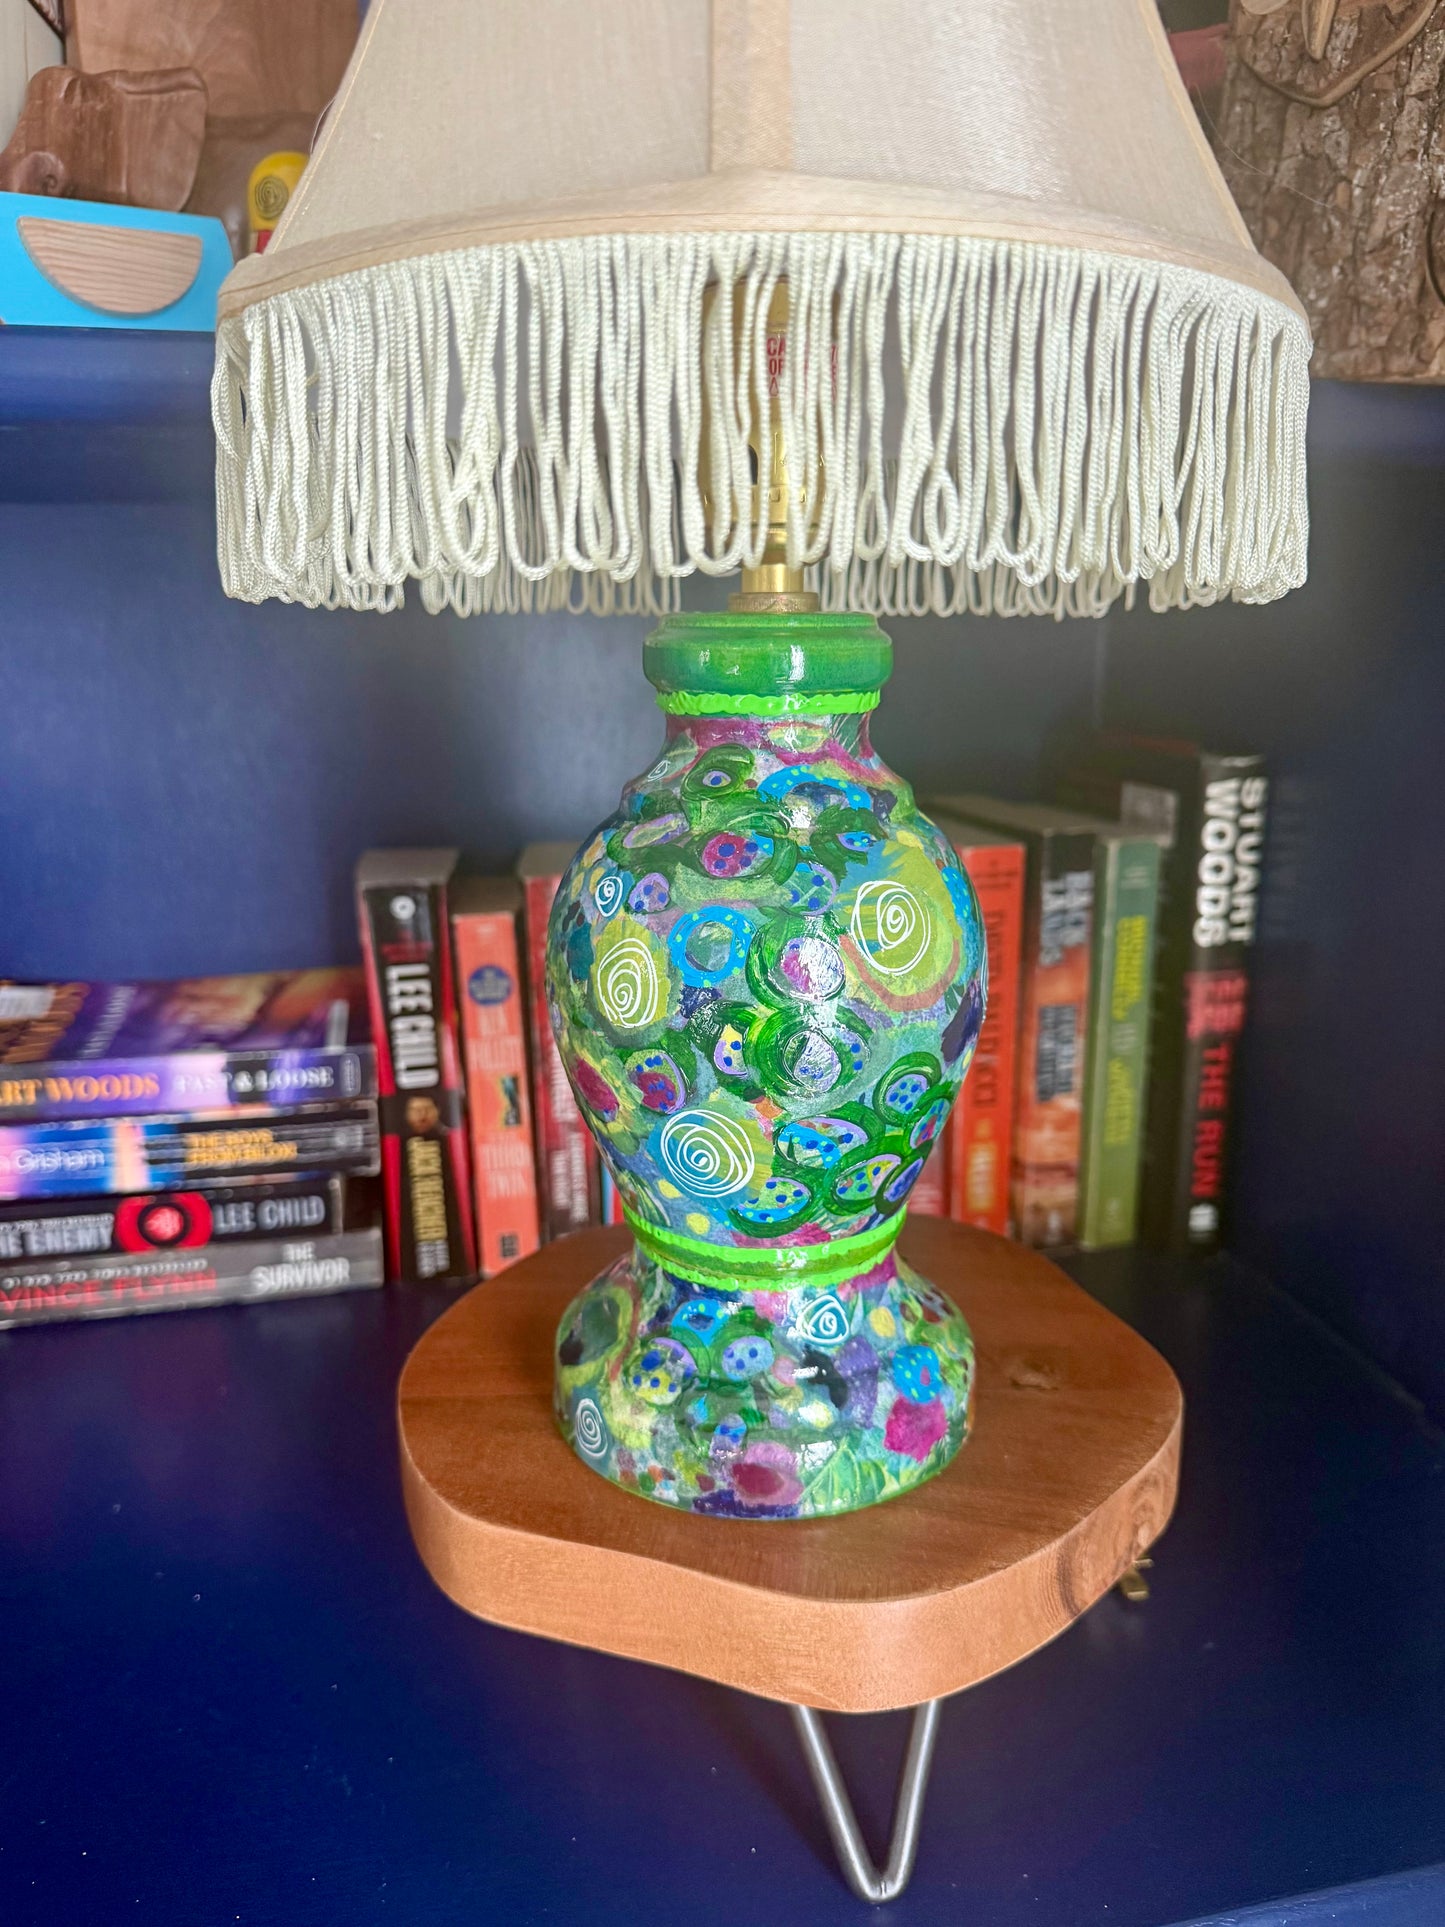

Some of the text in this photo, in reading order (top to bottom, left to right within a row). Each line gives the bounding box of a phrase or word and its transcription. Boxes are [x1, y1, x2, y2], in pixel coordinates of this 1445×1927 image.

[1193, 778, 1240, 947] WOODS
[1228, 777, 1267, 943] STUART
[386, 963, 433, 1015] LEE
[390, 1014, 440, 1090] CHILD
[44, 1073, 160, 1103] WOODS
[232, 1070, 254, 1093] &
[255, 1066, 334, 1092] LOOSE
[1197, 1044, 1229, 1111] THE
[14, 1149, 105, 1174] Grisham
[1190, 1120, 1224, 1197] RUN
[214, 1196, 326, 1234] LEE CHILD
[25, 1225, 113, 1256] ENEMY
[0, 1280, 103, 1313] VINCE
[113, 1270, 217, 1300] FLYNN
[252, 1257, 350, 1295] SURVIVOR
